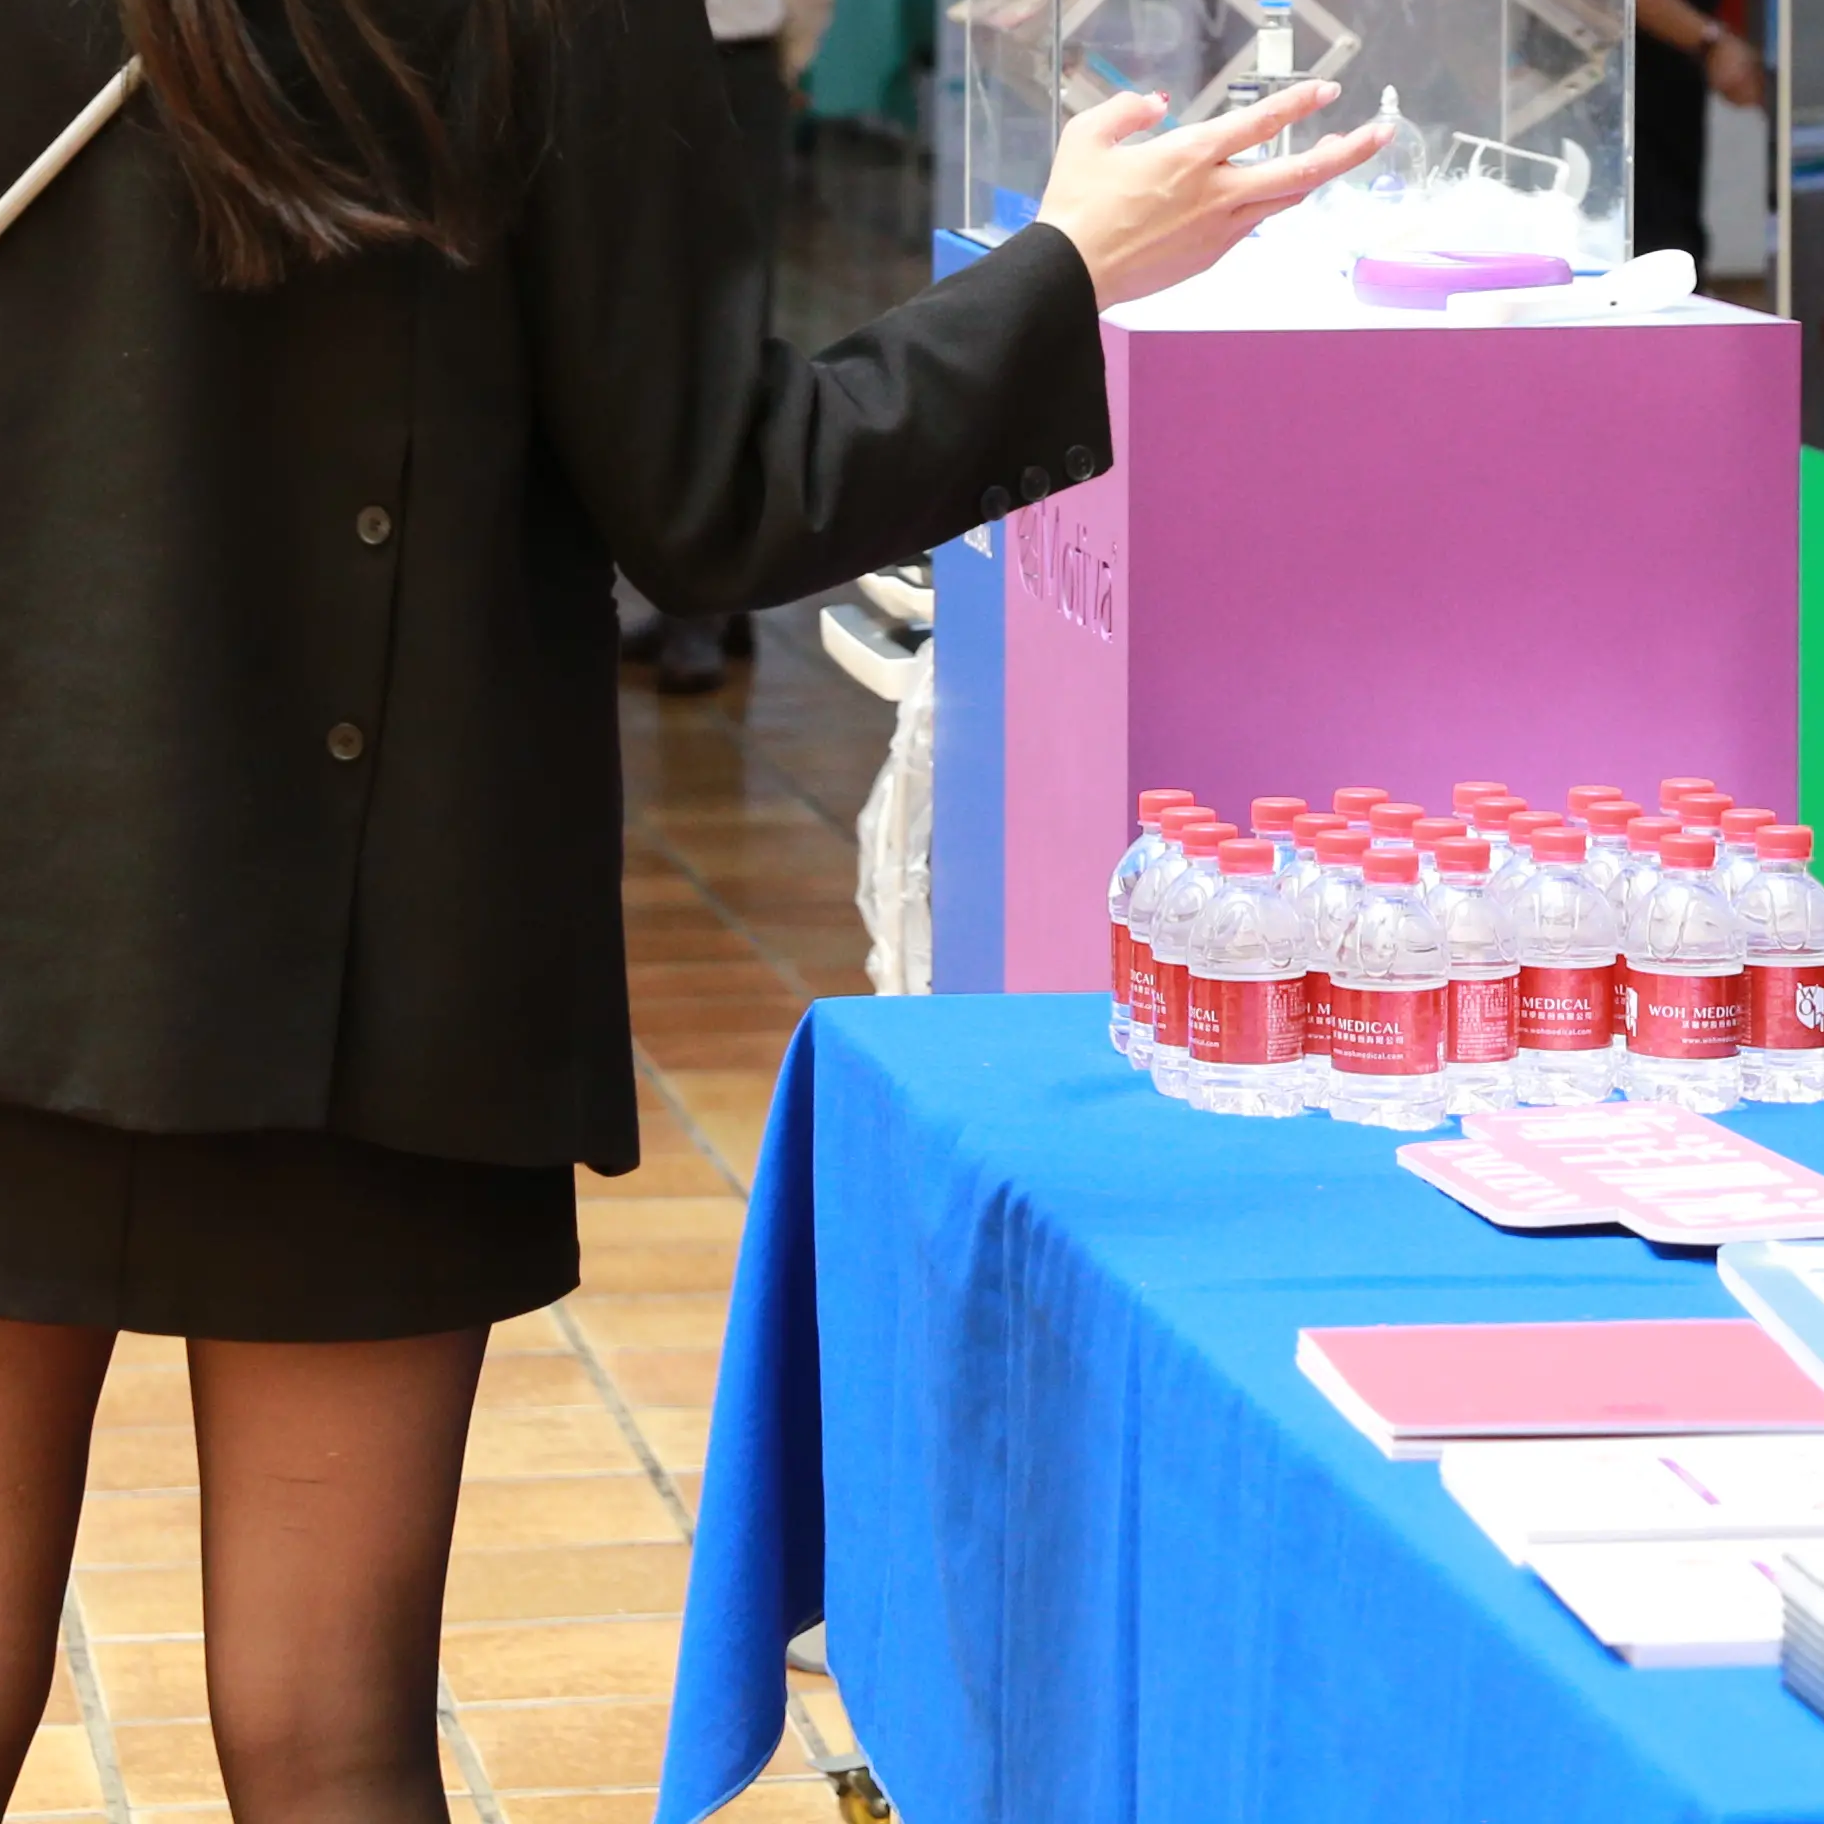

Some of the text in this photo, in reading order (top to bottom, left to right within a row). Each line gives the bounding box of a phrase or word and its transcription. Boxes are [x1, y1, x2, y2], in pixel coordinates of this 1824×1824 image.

[1522, 996, 1591, 1011] MEDICAL
[1648, 1004, 1686, 1019] WOH
[1337, 1017, 1404, 1035] MEDICAL
